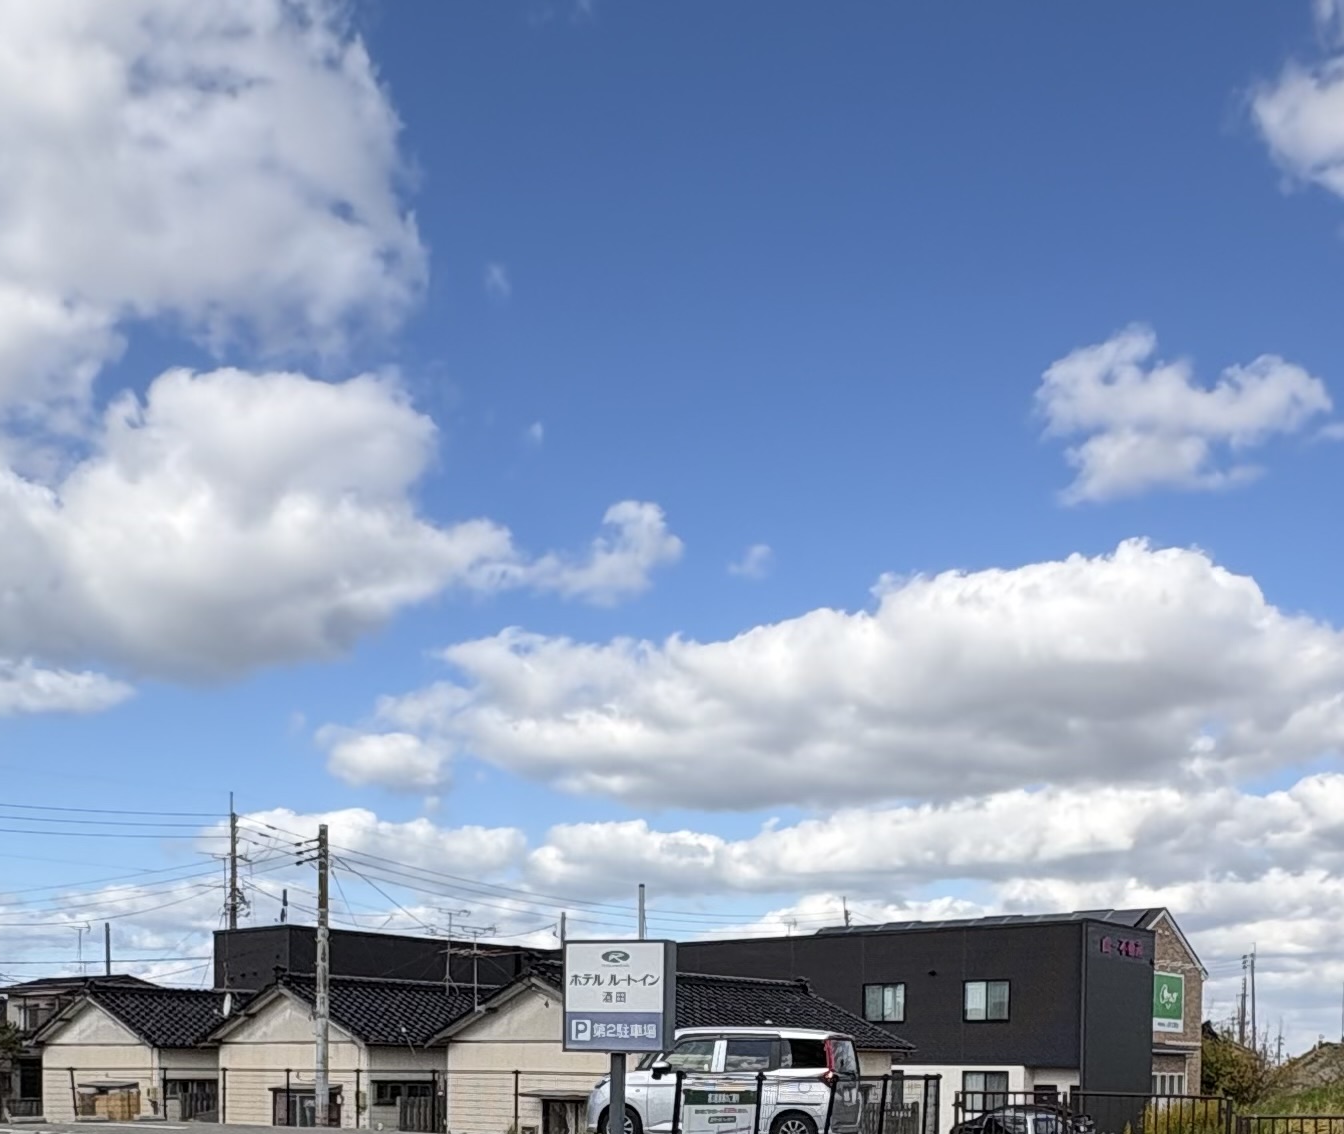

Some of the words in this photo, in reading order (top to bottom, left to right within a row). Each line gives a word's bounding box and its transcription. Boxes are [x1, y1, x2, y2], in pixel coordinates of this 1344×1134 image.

[570, 974, 604, 986] ホテル
[608, 974, 660, 986] ルートイン
[602, 991, 626, 1003] 酒田
[575, 1022, 587, 1039] P
[593, 1023, 657, 1038] 第2駐車場
